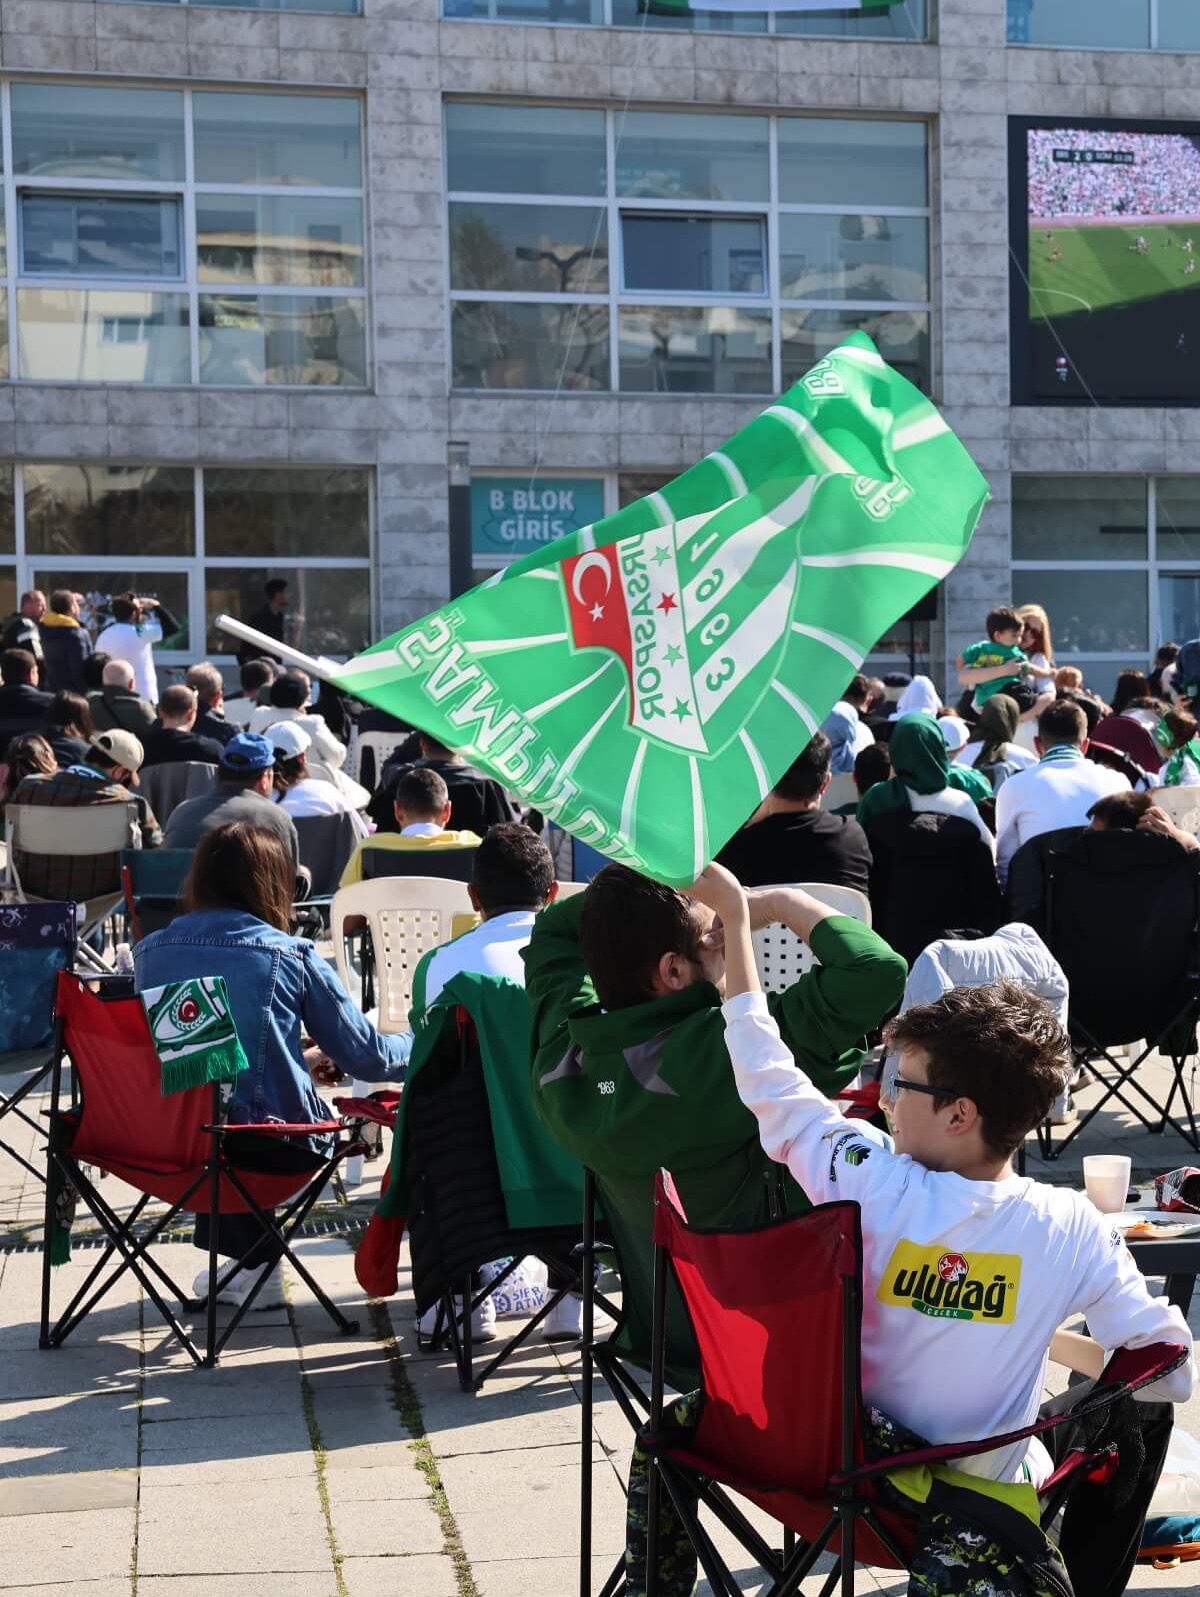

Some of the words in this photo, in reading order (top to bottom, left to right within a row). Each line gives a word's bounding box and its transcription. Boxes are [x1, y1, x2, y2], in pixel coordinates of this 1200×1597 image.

[490, 489, 505, 511] B
[512, 489, 575, 511] BLOK
[893, 1264, 1007, 1318] uludağ
[515, 1293, 545, 1312] ATIK
